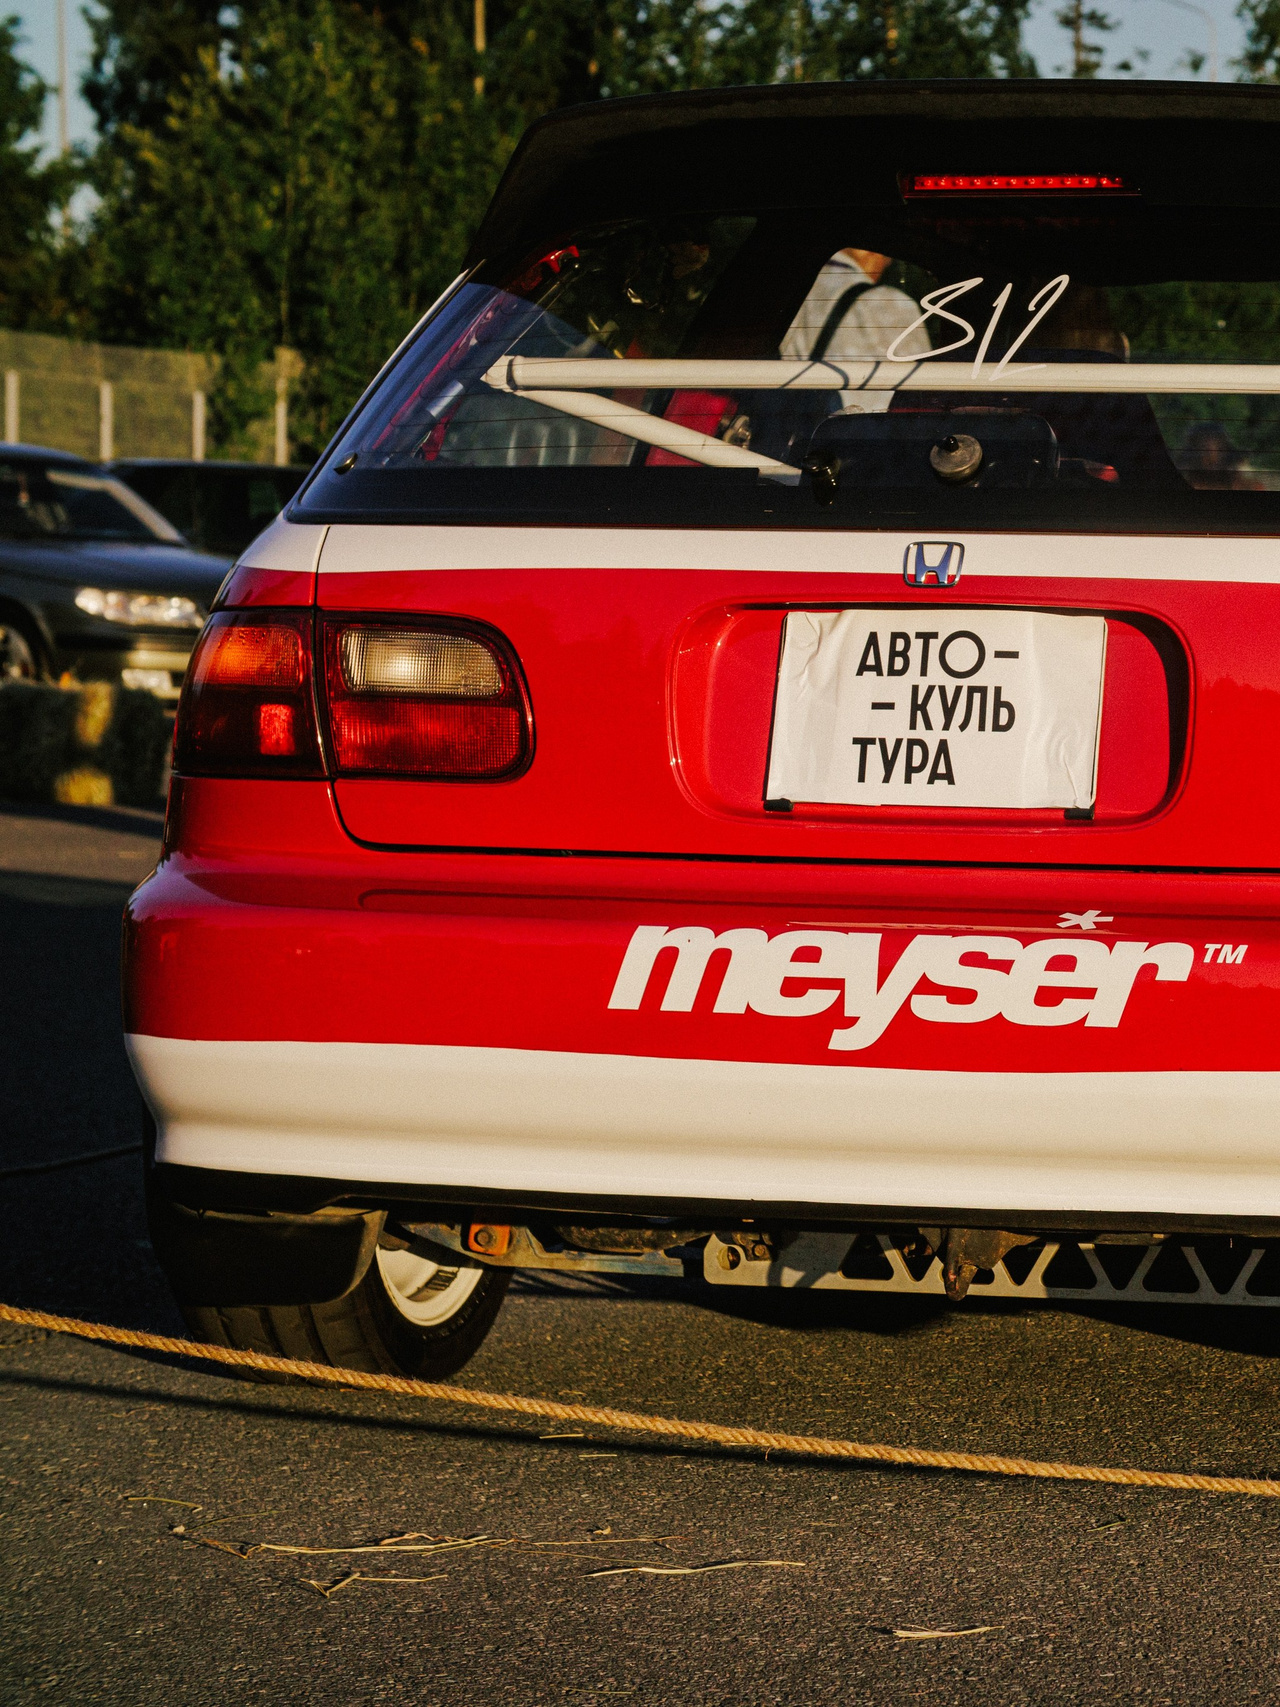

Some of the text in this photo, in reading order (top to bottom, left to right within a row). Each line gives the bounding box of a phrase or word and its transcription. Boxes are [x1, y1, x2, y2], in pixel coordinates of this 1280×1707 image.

[886, 274, 1070, 382] 812
[852, 737, 956, 786] ТУРА
[607, 925, 1195, 1052] meyser
